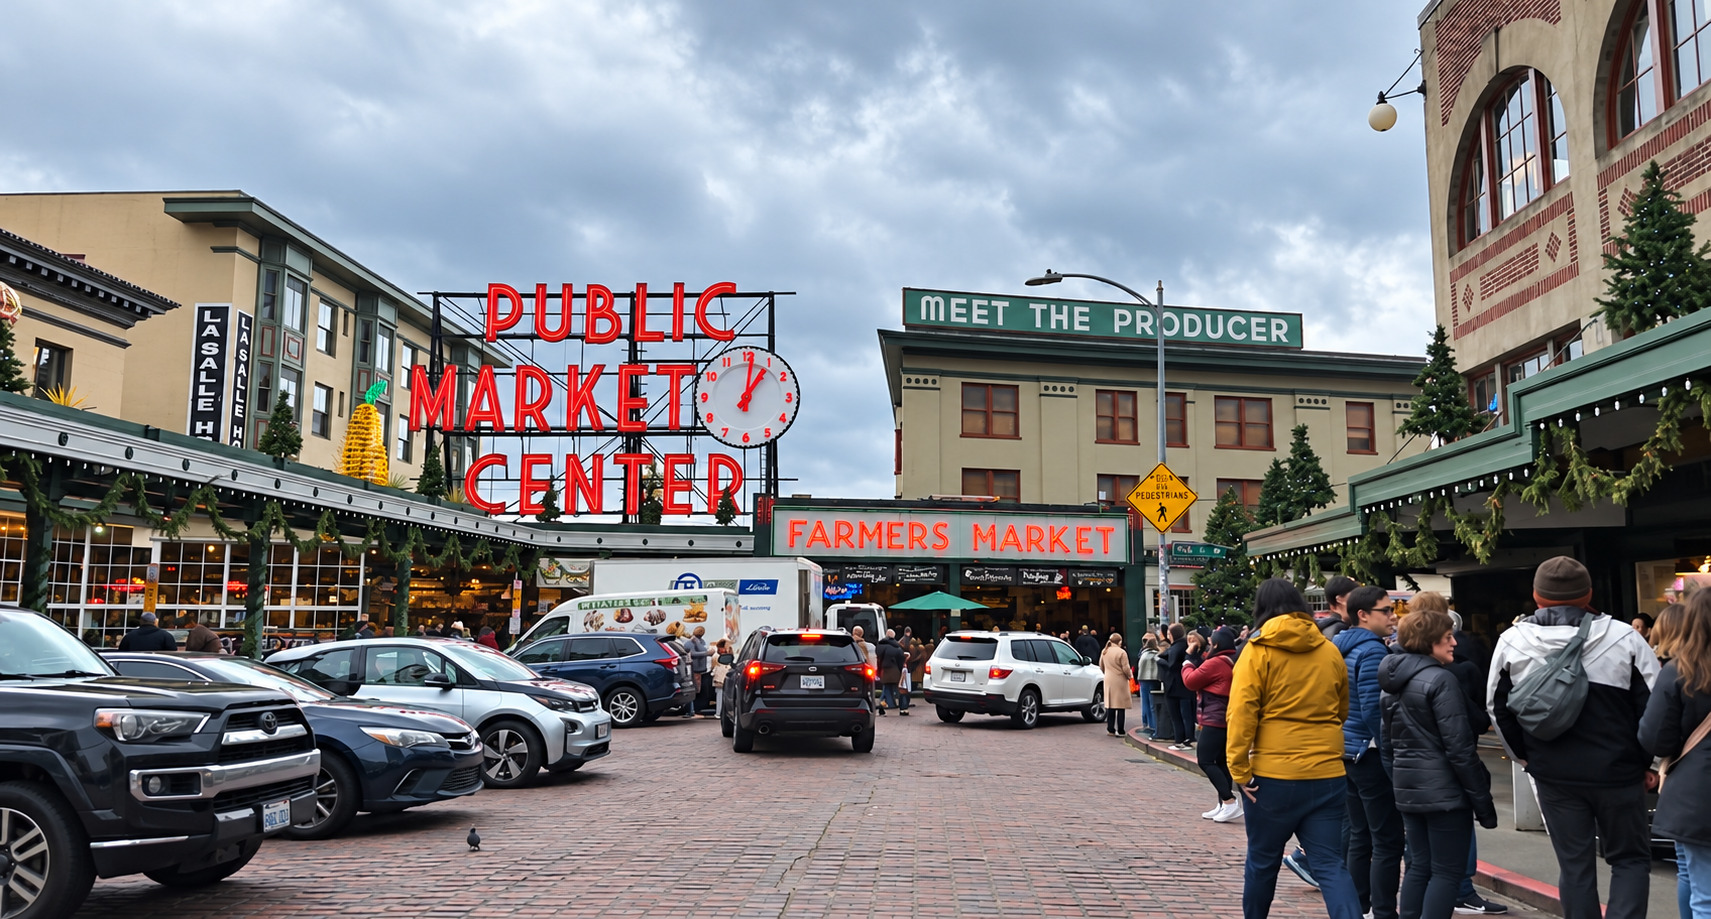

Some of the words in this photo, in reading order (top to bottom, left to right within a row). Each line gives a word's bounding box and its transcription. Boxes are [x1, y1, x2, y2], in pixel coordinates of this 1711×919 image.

[486, 281, 737, 344] PUBLIC
[920, 295, 1010, 326] MEET
[1029, 302, 1090, 332] THE
[1114, 308, 1289, 343] PRODUCER
[197, 310, 221, 411] LASALLE
[722, 357, 731, 367] 11
[742, 351, 755, 362] 12
[767, 357, 771, 367] 1
[235, 317, 249, 418] LASALLE
[706, 371, 717, 382] 10
[780, 371, 787, 382] 2
[408, 363, 698, 433] MARKET
[701, 392, 708, 403] 9
[785, 392, 793, 403] 3
[706, 412, 714, 423] 8
[779, 412, 787, 423] 4
[721, 427, 729, 438] 7
[742, 432, 750, 443] 6
[764, 427, 771, 438] 5
[464, 453, 743, 516] CENTER
[788, 519, 950, 550] FARMERS
[972, 523, 1115, 554] MARKET
